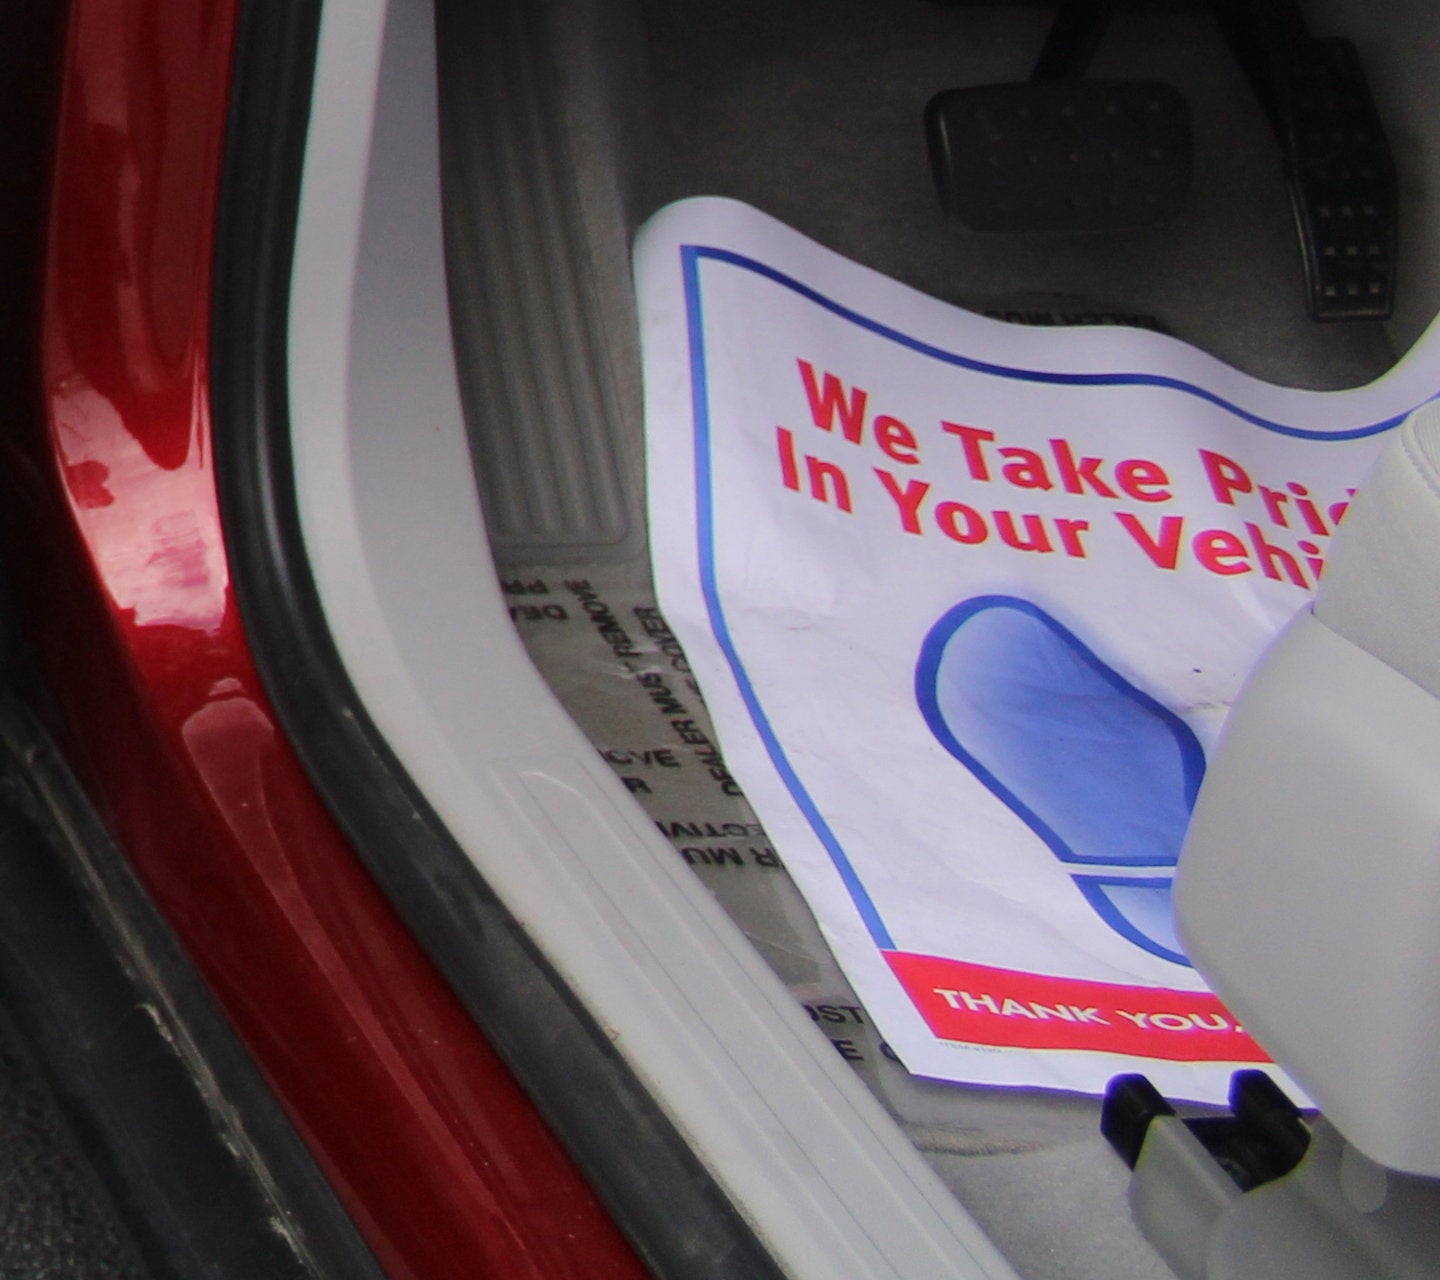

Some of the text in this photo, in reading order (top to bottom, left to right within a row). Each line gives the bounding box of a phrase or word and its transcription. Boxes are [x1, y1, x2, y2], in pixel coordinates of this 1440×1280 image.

[775, 425, 854, 515] In
[871, 466, 1090, 559] Your
[796, 357, 921, 466] We
[940, 420, 1173, 503] Take
[933, 987, 1111, 1026] THANK
